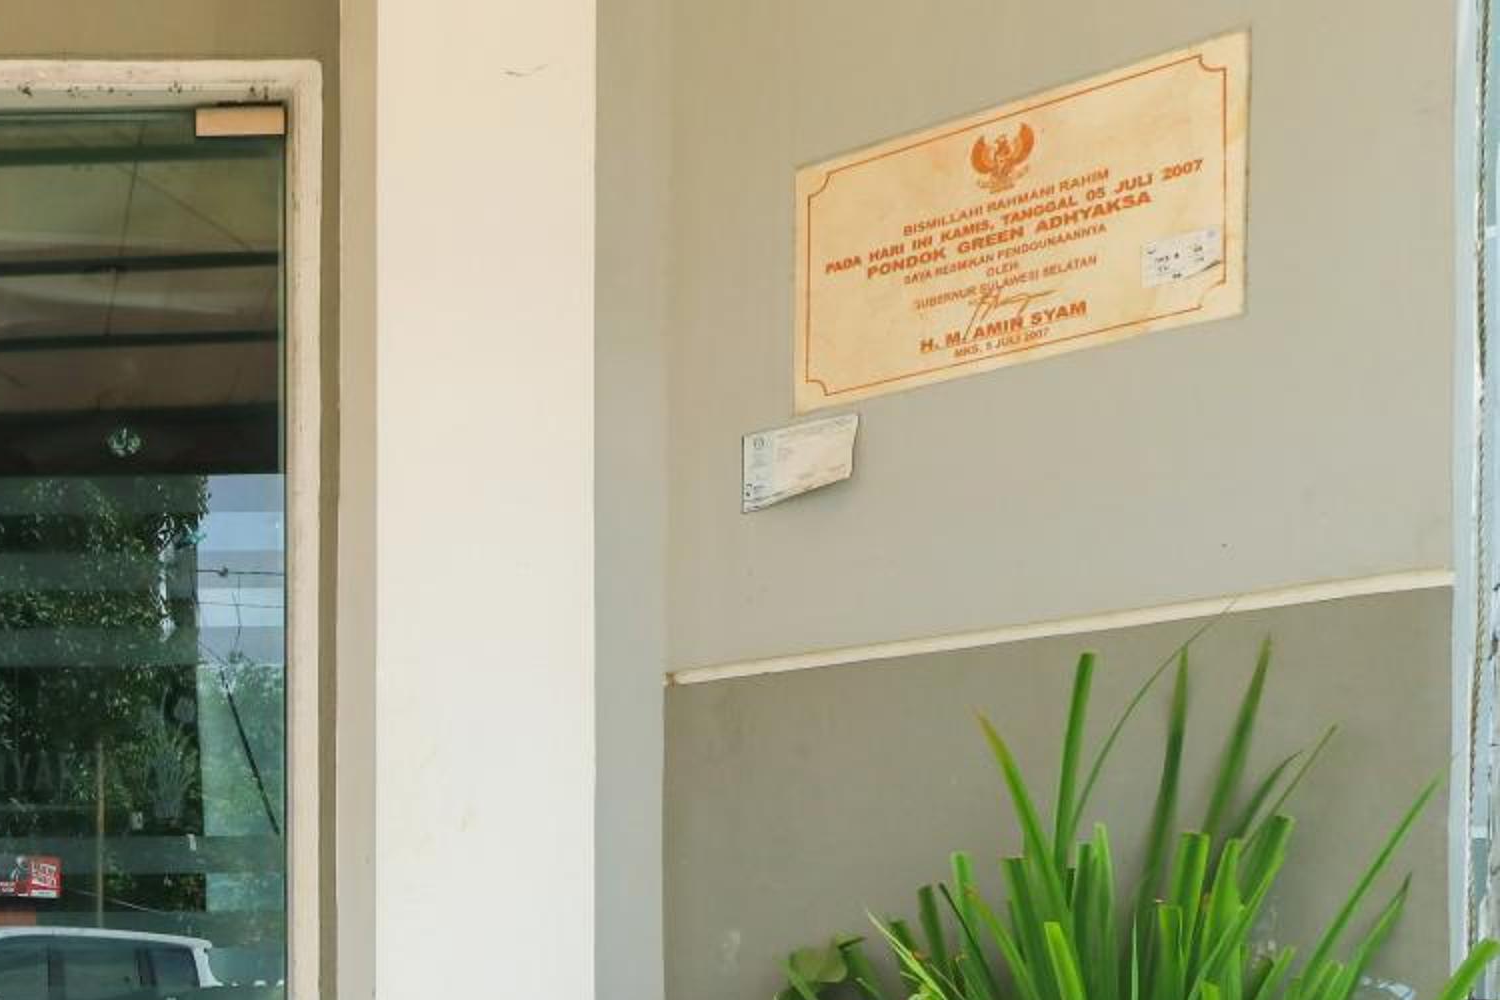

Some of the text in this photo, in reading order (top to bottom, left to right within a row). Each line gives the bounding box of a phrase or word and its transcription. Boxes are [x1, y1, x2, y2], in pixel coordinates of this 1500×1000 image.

[987, 186, 1054, 213] RAHMANI
[1059, 168, 1109, 192] RAHIM
[825, 256, 862, 274] PADA
[869, 244, 904, 262] HARI
[912, 235, 933, 250] INI
[1002, 196, 1078, 225] TANGGAL
[1085, 187, 1105, 201] 05
[1114, 173, 1153, 193] JULI
[1162, 159, 1204, 181] 2007
[867, 191, 1152, 279] PONDOK GREEN ADHYAKSA
[979, 270, 1039, 294] SULAWESI
[1043, 256, 1097, 275] SELATAN
[986, 262, 1019, 278] OLEH
[920, 338, 940, 354] H.
[974, 317, 1023, 339] AMIN
[1030, 301, 1088, 325] SYAM
